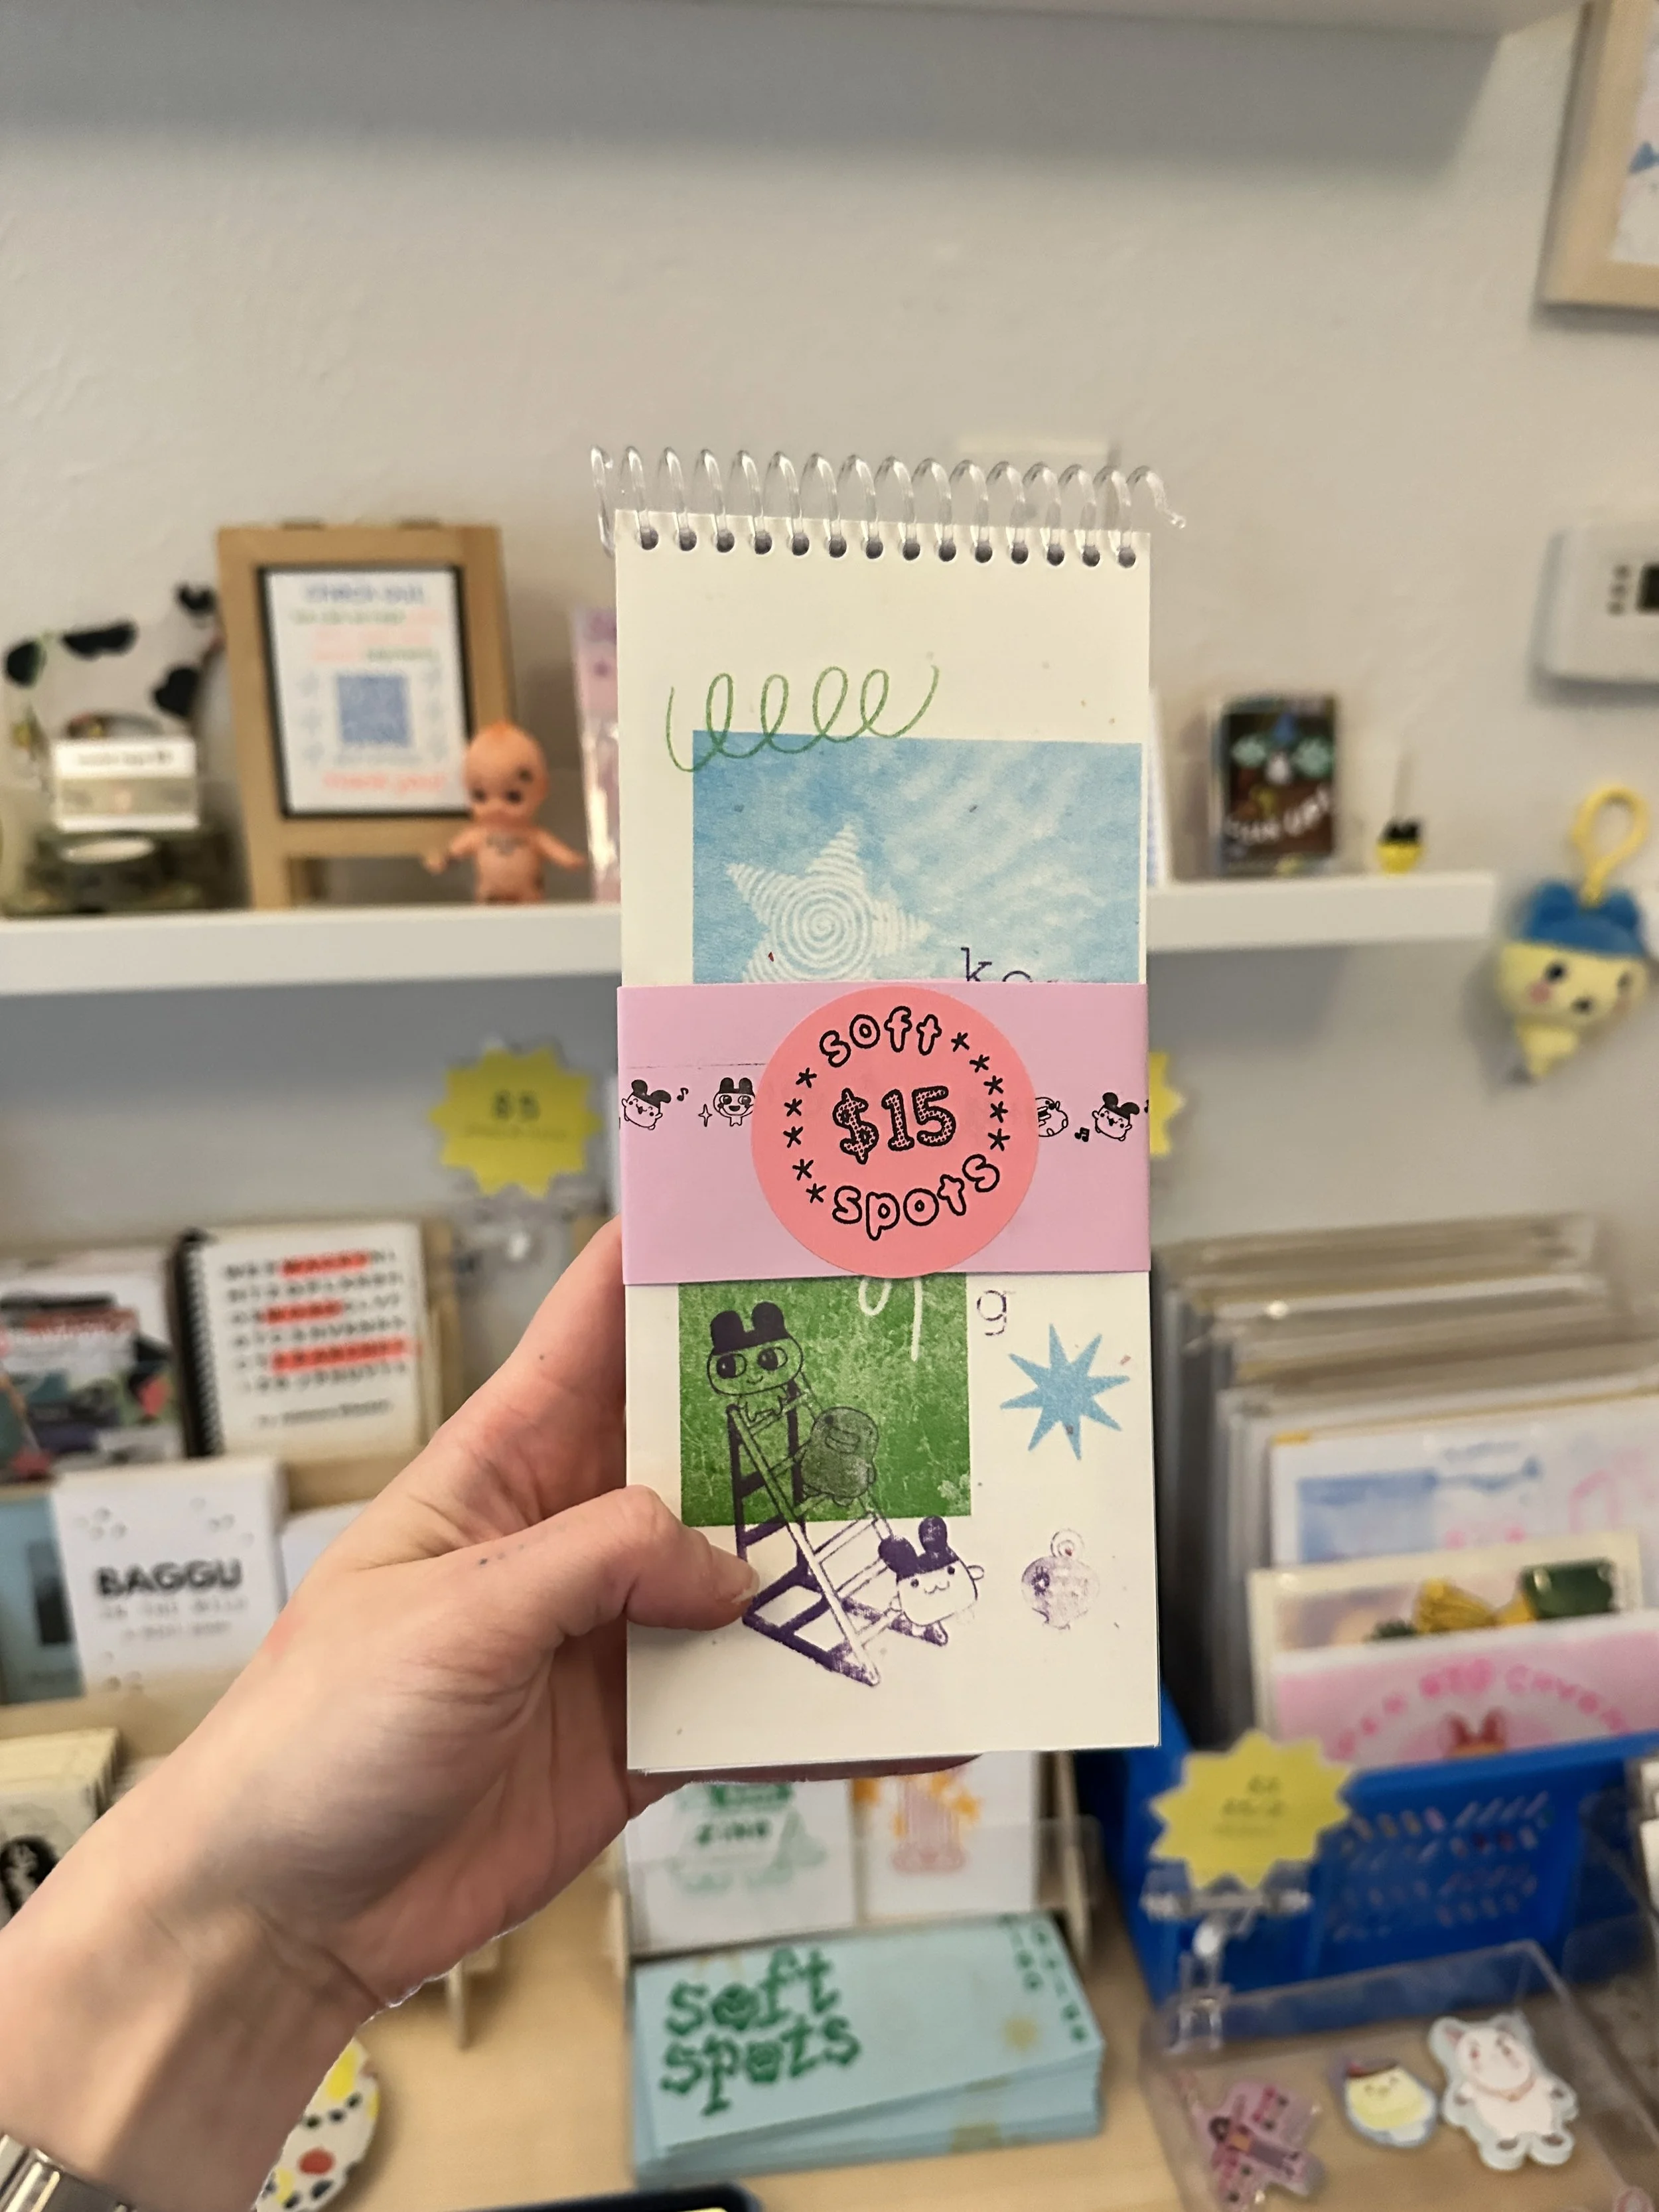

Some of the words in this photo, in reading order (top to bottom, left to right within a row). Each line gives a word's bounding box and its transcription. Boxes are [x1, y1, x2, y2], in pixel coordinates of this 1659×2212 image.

[819, 1005, 942, 1067] soft
[831, 1084, 957, 1165] $15
[831, 1153, 1001, 1241] spots
[96, 1558, 243, 1597] BAGGU
